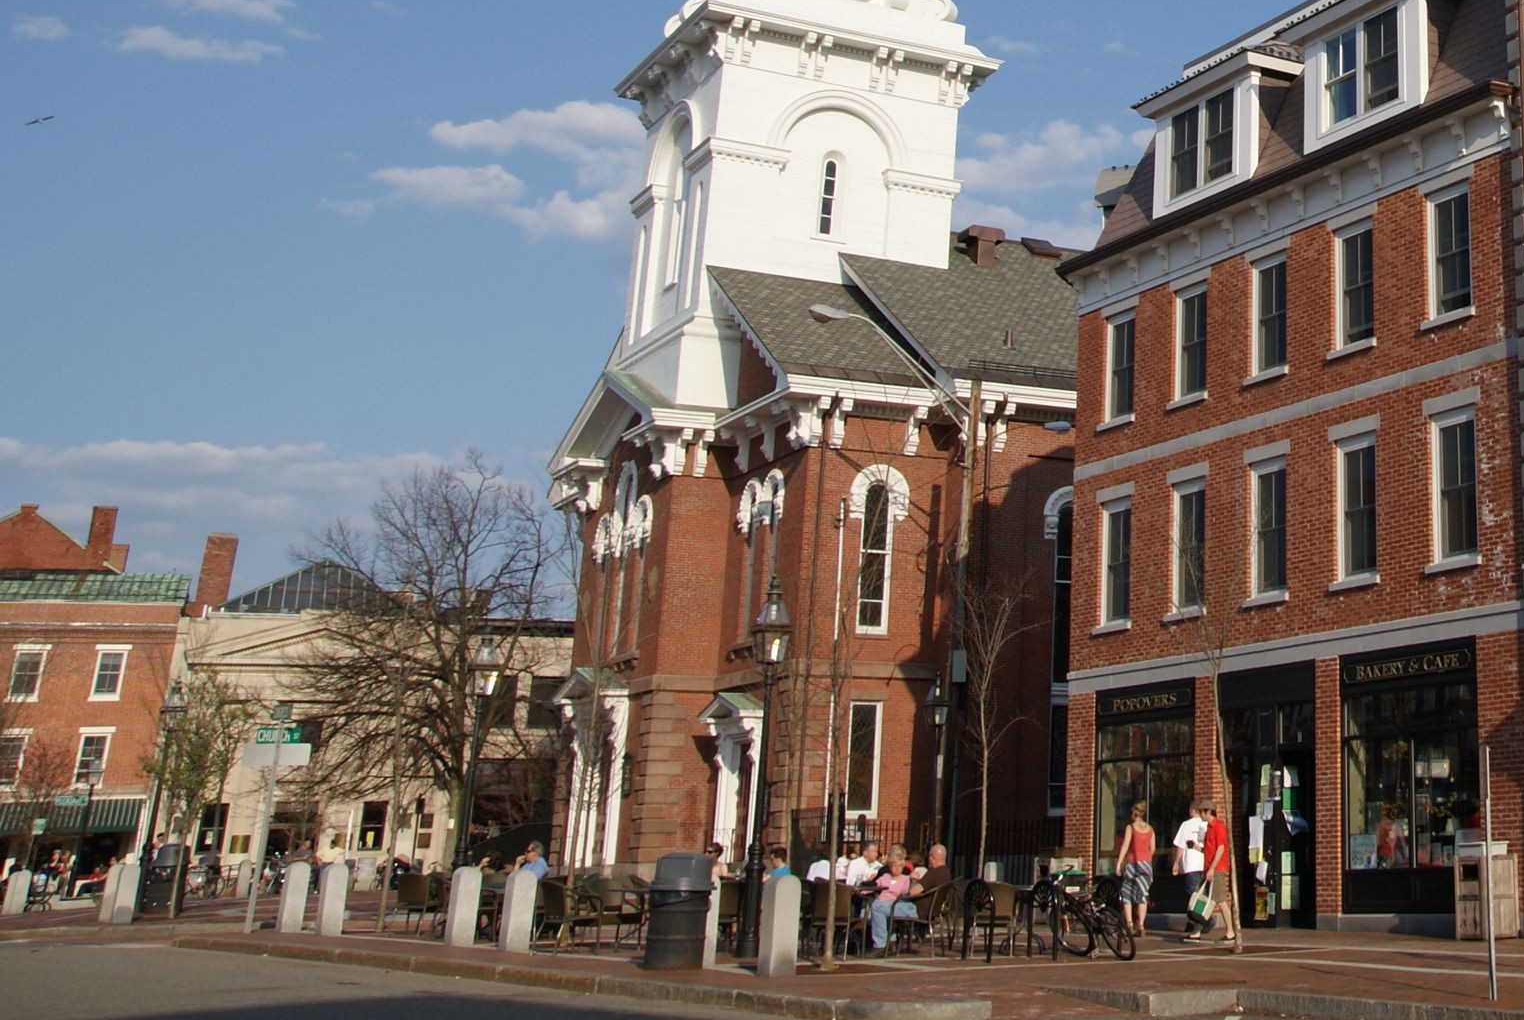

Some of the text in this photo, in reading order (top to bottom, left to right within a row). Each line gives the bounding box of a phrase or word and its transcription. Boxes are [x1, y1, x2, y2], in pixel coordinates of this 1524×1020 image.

[1356, 660, 1407, 680] BAKERY
[1408, 658, 1420, 673] &
[1112, 692, 1177, 712] POPOVERS
[257, 729, 290, 742] CHUCH
